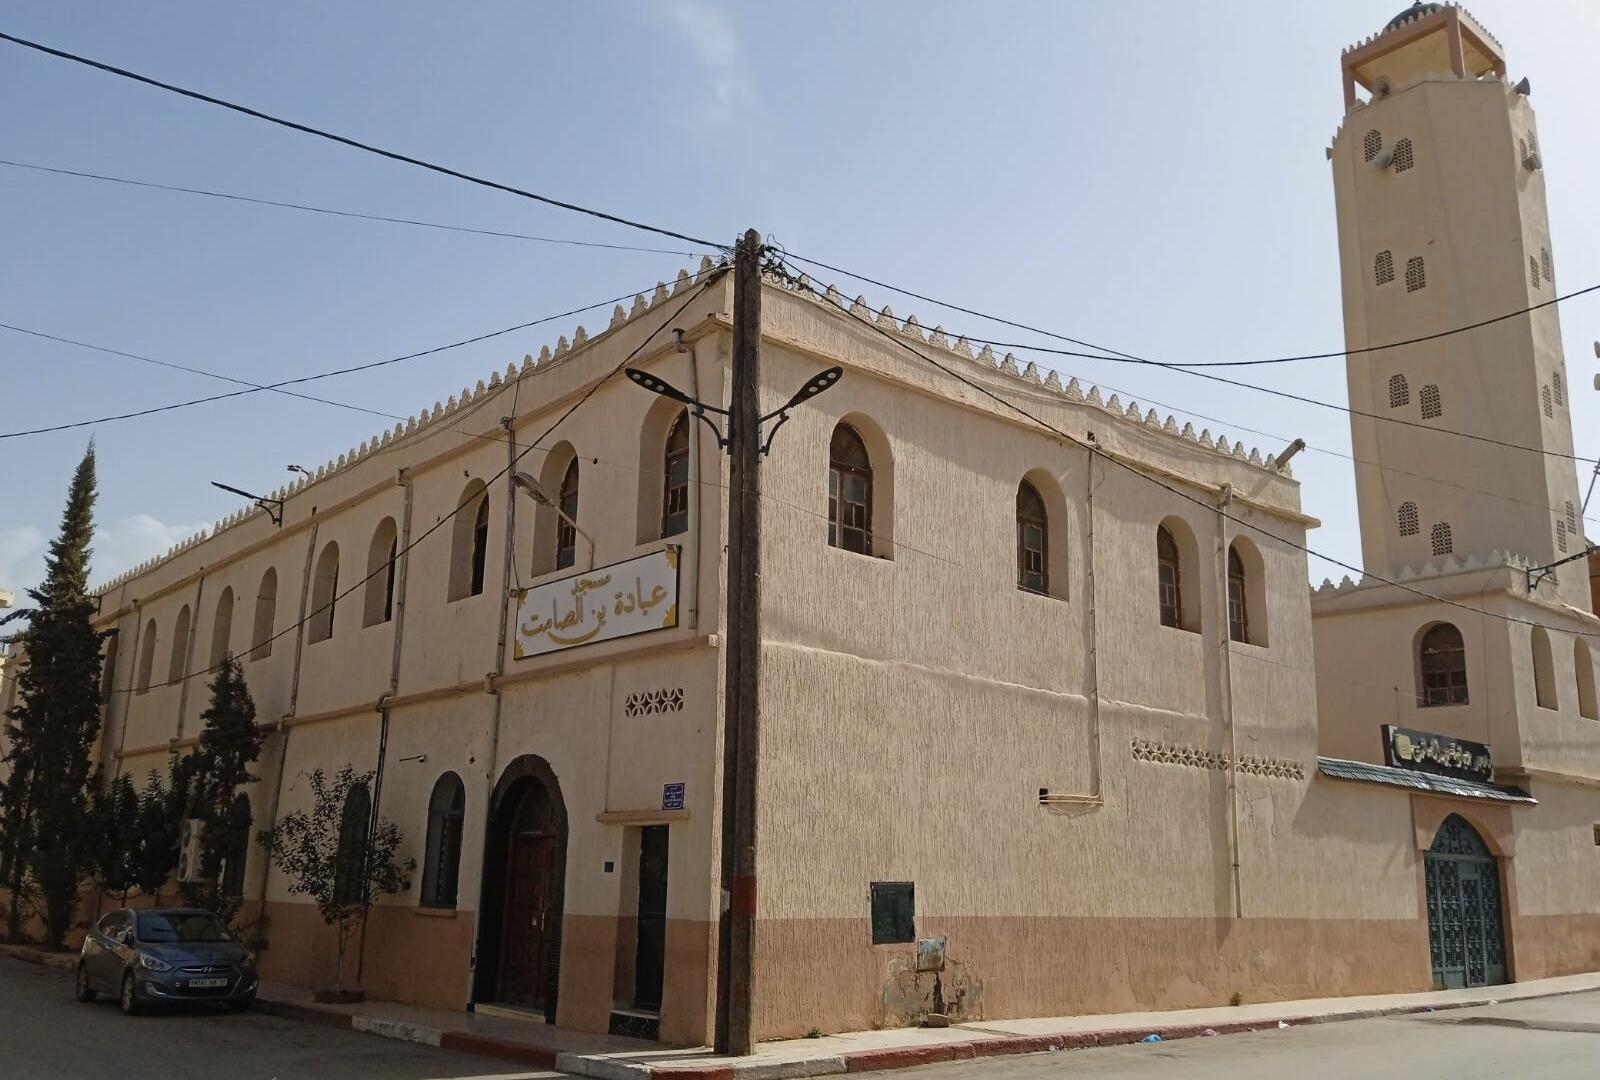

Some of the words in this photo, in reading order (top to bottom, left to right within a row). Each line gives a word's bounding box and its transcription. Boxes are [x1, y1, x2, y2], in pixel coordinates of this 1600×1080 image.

[571, 574, 611, 596] مسجد
[614, 576, 668, 616] عبادة
[521, 593, 584, 636] الصامت
[547, 605, 607, 645] بن
